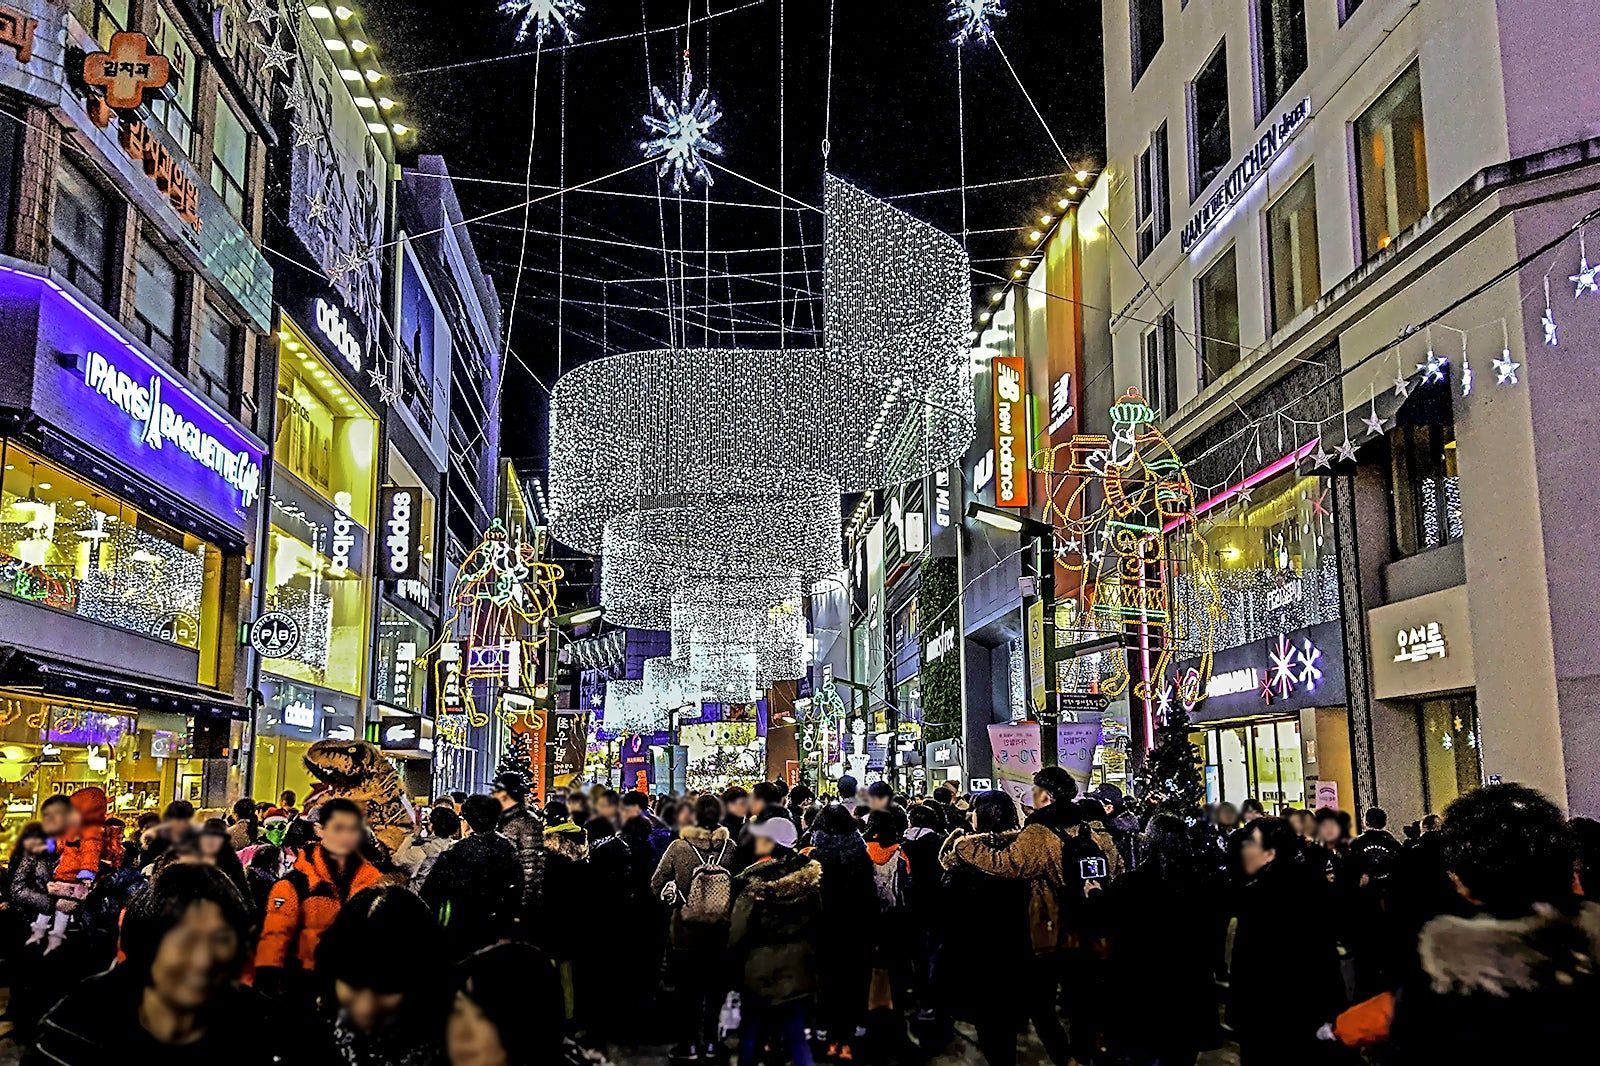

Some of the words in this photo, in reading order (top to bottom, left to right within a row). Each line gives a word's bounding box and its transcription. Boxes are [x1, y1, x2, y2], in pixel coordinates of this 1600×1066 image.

[1225, 123, 1277, 204] KITCHEN
[85, 351, 150, 421] PARIS
[160, 403, 240, 490] BAGUETTE
[999, 402, 1012, 434] new
[999, 436, 1016, 502] balance
[387, 491, 412, 574] adidas
[935, 488, 950, 528] MLB
[1393, 621, 1447, 662] 오설록
